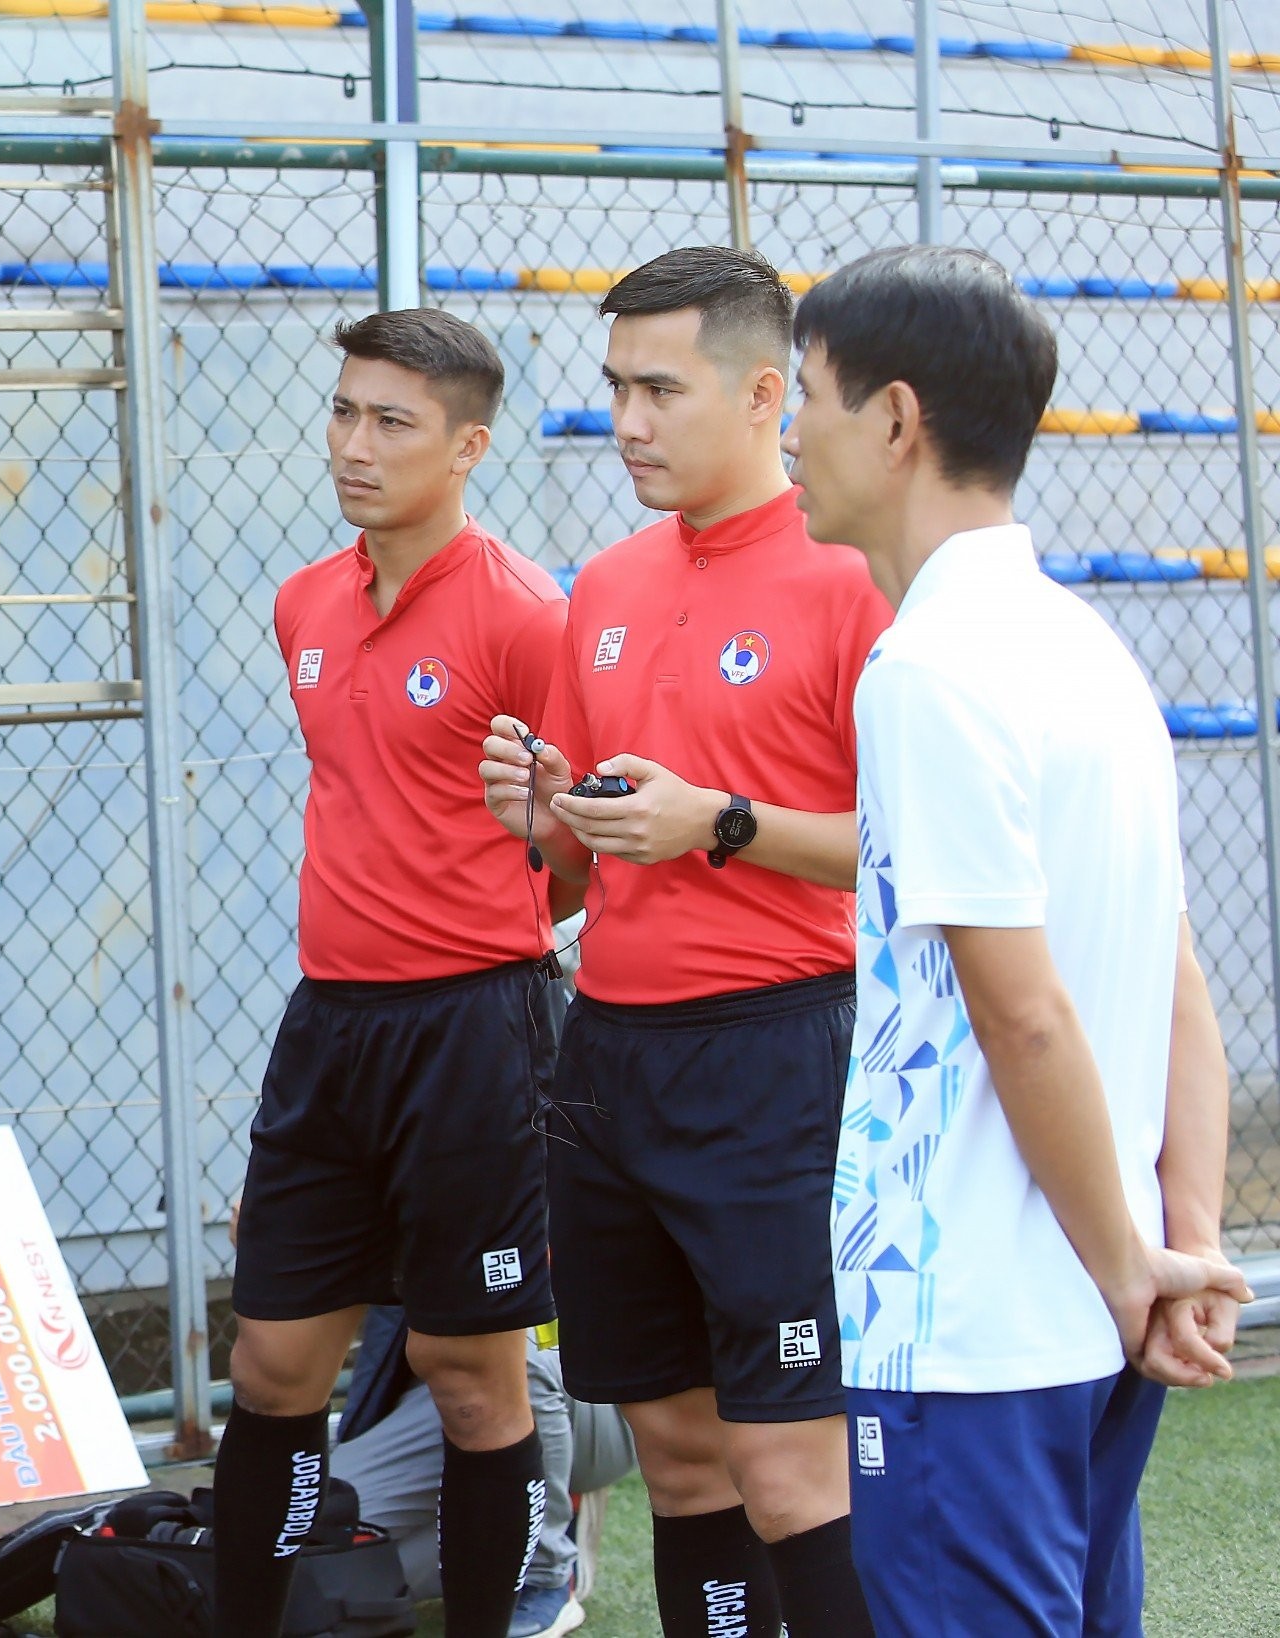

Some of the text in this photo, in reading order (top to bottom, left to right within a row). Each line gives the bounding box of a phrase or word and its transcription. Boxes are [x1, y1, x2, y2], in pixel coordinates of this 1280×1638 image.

[602, 631, 623, 646] JG
[302, 653, 320, 665] JG
[598, 647, 616, 661] BL
[300, 668, 316, 679] BL
[488, 1252, 515, 1268] JG
[21, 1238, 57, 1298] NEST
[489, 1268, 518, 1282] BL
[784, 1324, 813, 1340] JG
[784, 1342, 815, 1357] BL
[274, 1451, 321, 1557] JOGARBOLA
